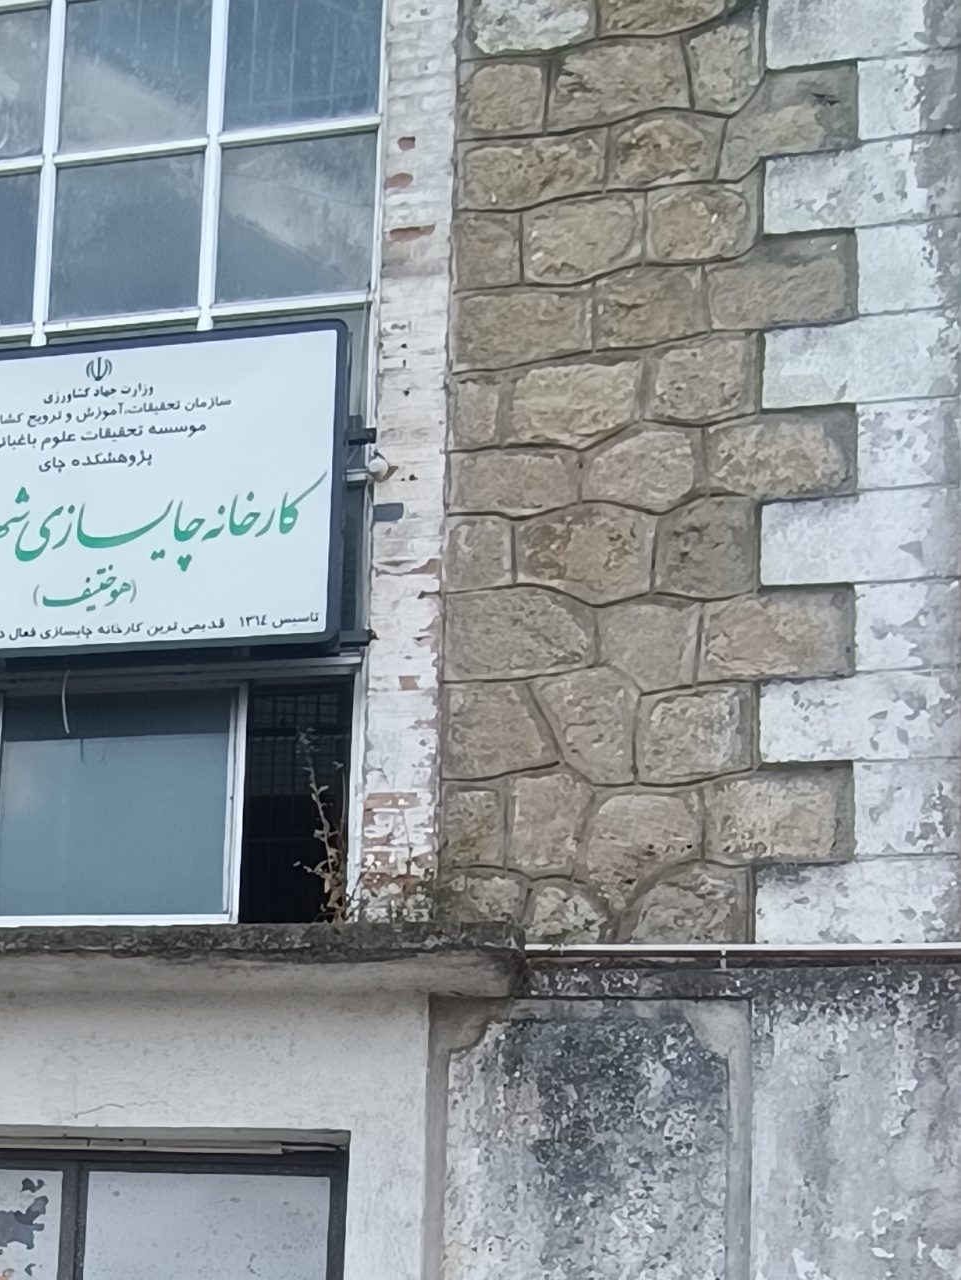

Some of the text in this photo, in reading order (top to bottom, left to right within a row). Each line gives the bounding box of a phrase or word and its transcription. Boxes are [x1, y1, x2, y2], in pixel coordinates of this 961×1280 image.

[121, 382, 154, 397] وزارت
[184, 395, 232, 412] سازمان
[26, 410, 63, 428] ترویج
[64, 412, 73, 424] و
[80, 425, 144, 442] تحقیقات
[148, 423, 207, 438] موسسه
[40, 430, 77, 451] علوم
[38, 449, 153, 473] پژوهشکده چای
[201, 470, 328, 542] کارخانه
[97, 621, 143, 635] کارخانه
[181, 617, 225, 634] قدیمی
[271, 611, 319, 629] تاسیس
[8, 627, 37, 641] فعال
[146, 621, 178, 637] ترین
